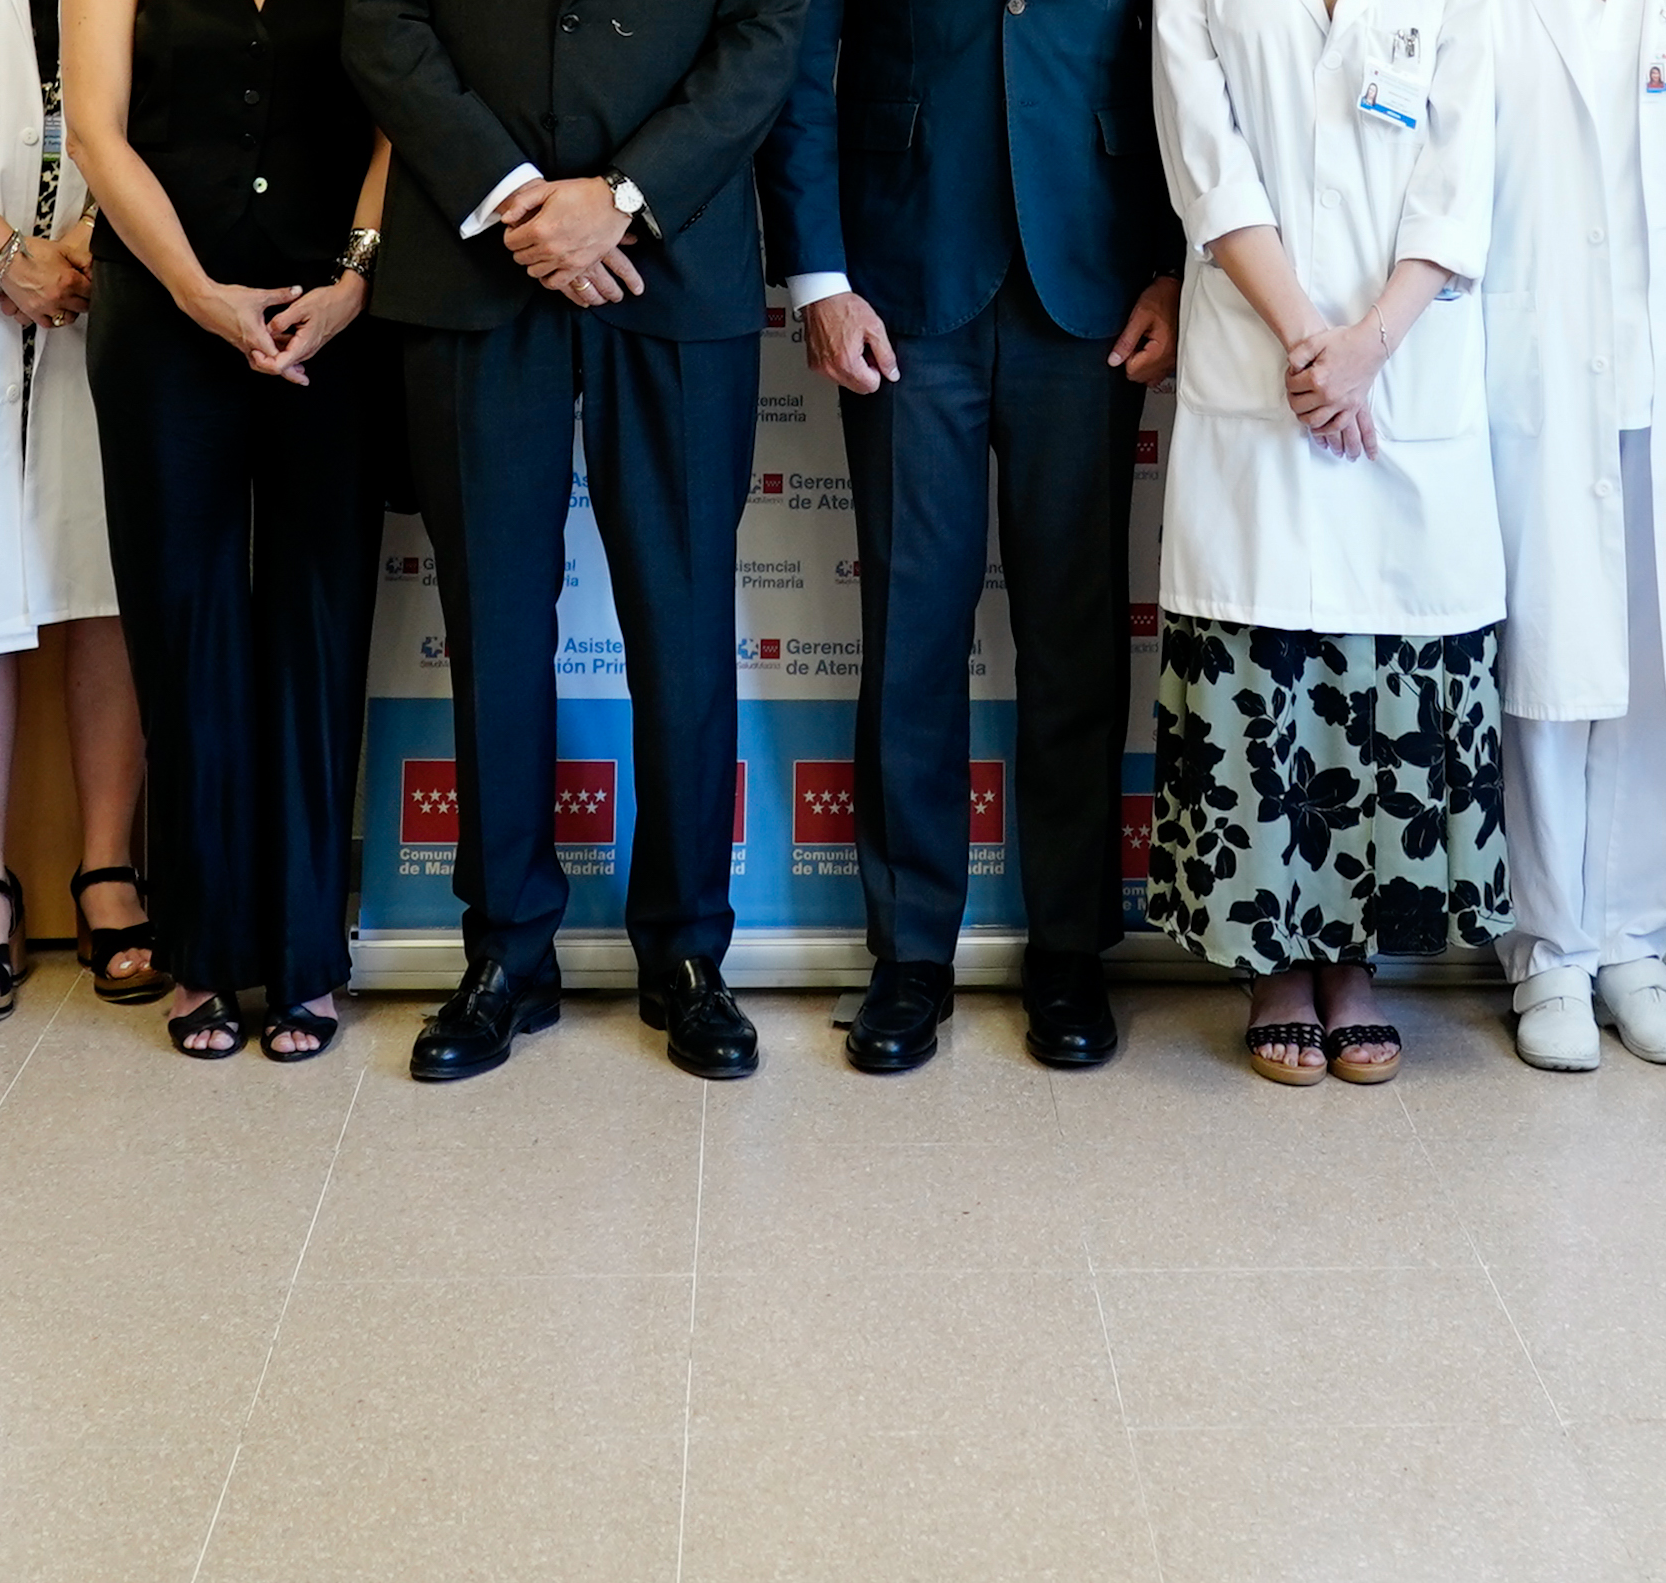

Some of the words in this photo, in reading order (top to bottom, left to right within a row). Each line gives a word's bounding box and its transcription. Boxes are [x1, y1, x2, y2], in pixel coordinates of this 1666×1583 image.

[758, 395, 804, 407] encial
[758, 410, 807, 422] rimaria
[788, 494, 812, 509] de
[737, 560, 801, 573] istencial
[742, 575, 804, 589] Primaria
[563, 637, 624, 654] Asiste
[786, 639, 862, 655] Gerenci
[786, 660, 809, 676] de
[815, 660, 862, 676] Aten
[400, 848, 457, 861] Comuni
[792, 848, 857, 861] Comunid
[399, 862, 420, 875] de
[791, 862, 813, 875] de
[818, 862, 860, 875] Madr
[968, 862, 1005, 875] drid
